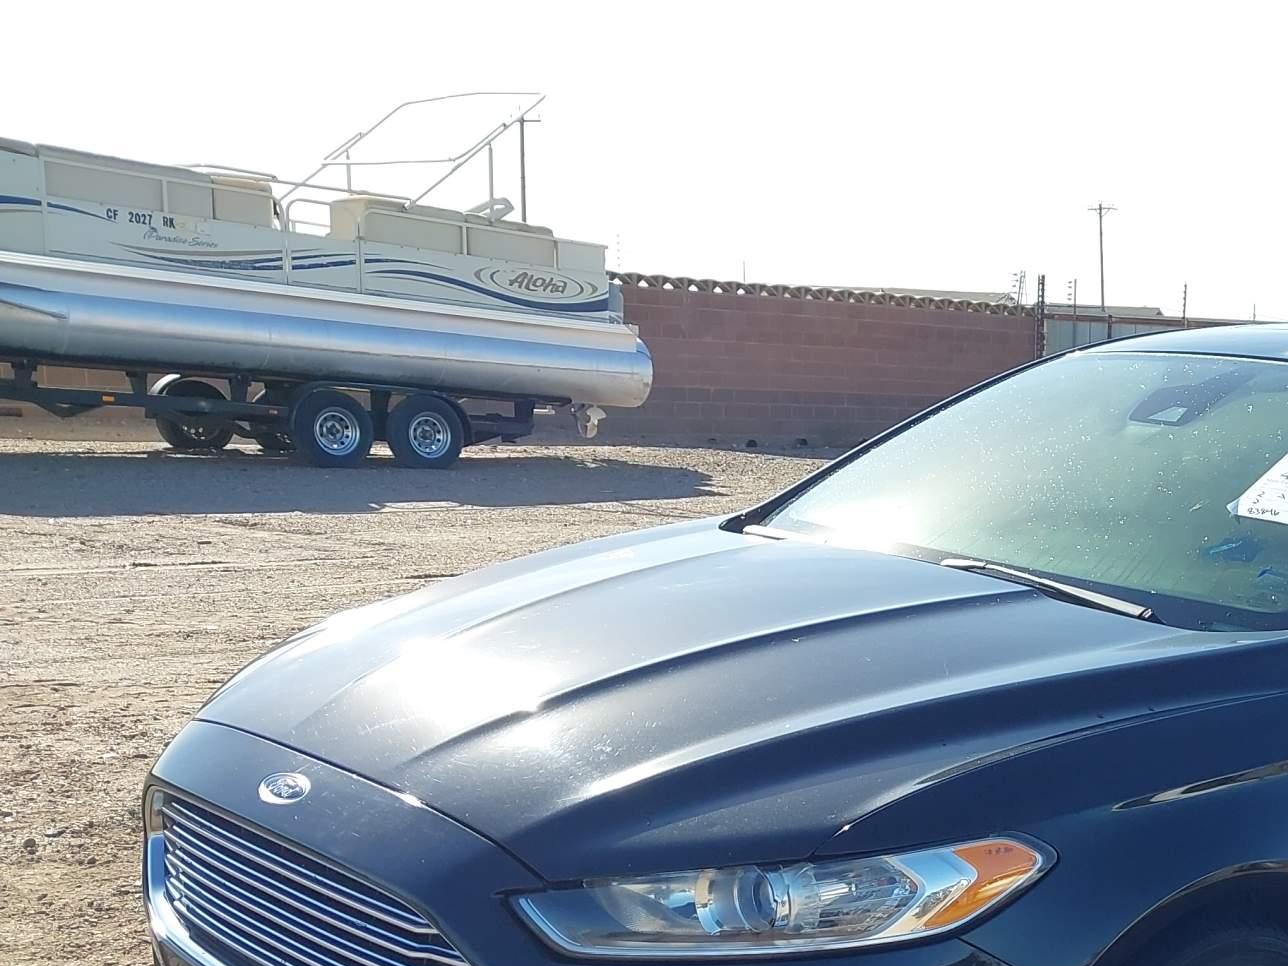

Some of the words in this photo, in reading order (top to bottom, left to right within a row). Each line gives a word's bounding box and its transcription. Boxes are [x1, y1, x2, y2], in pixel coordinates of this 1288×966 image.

[106, 207, 119, 221] CF
[128, 211, 153, 226] 2027
[162, 216, 176, 229] RK
